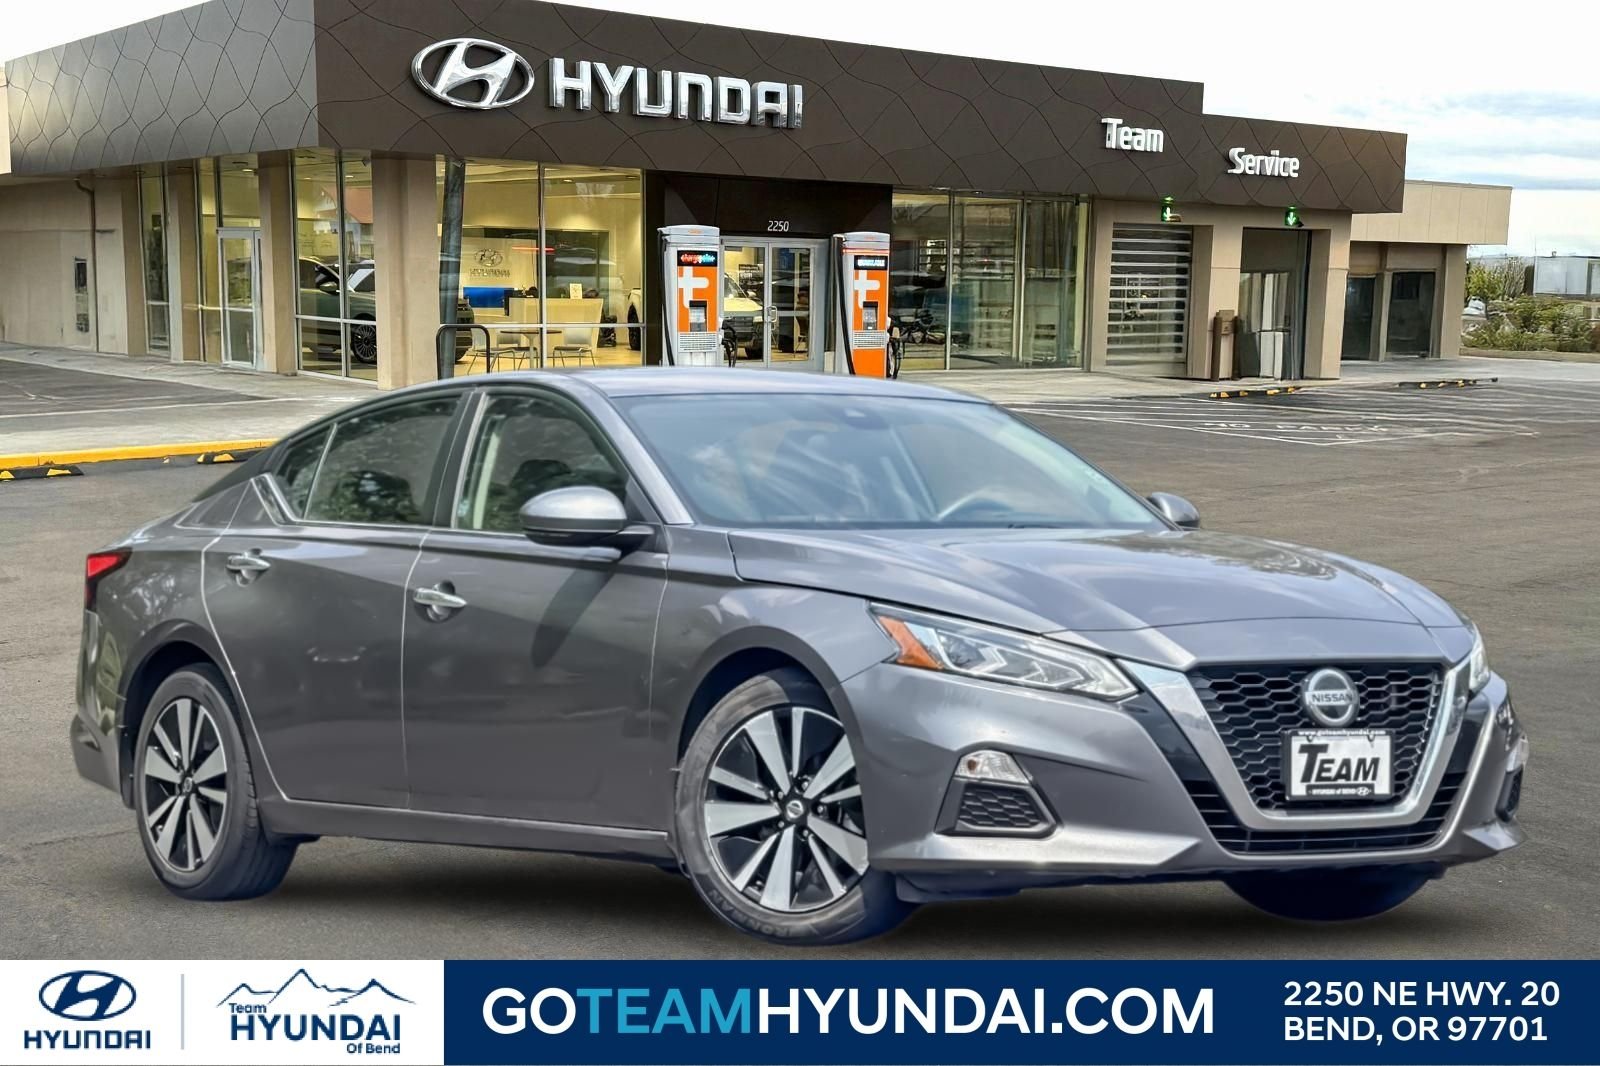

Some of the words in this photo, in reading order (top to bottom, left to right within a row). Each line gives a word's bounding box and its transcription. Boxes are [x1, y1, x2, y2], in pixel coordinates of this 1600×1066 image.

[549, 57, 804, 129] HYUNDAI
[1101, 117, 1165, 153] Team
[1227, 146, 1301, 179] Service
[767, 219, 789, 232] 2250
[1310, 693, 1354, 704] NISSAN
